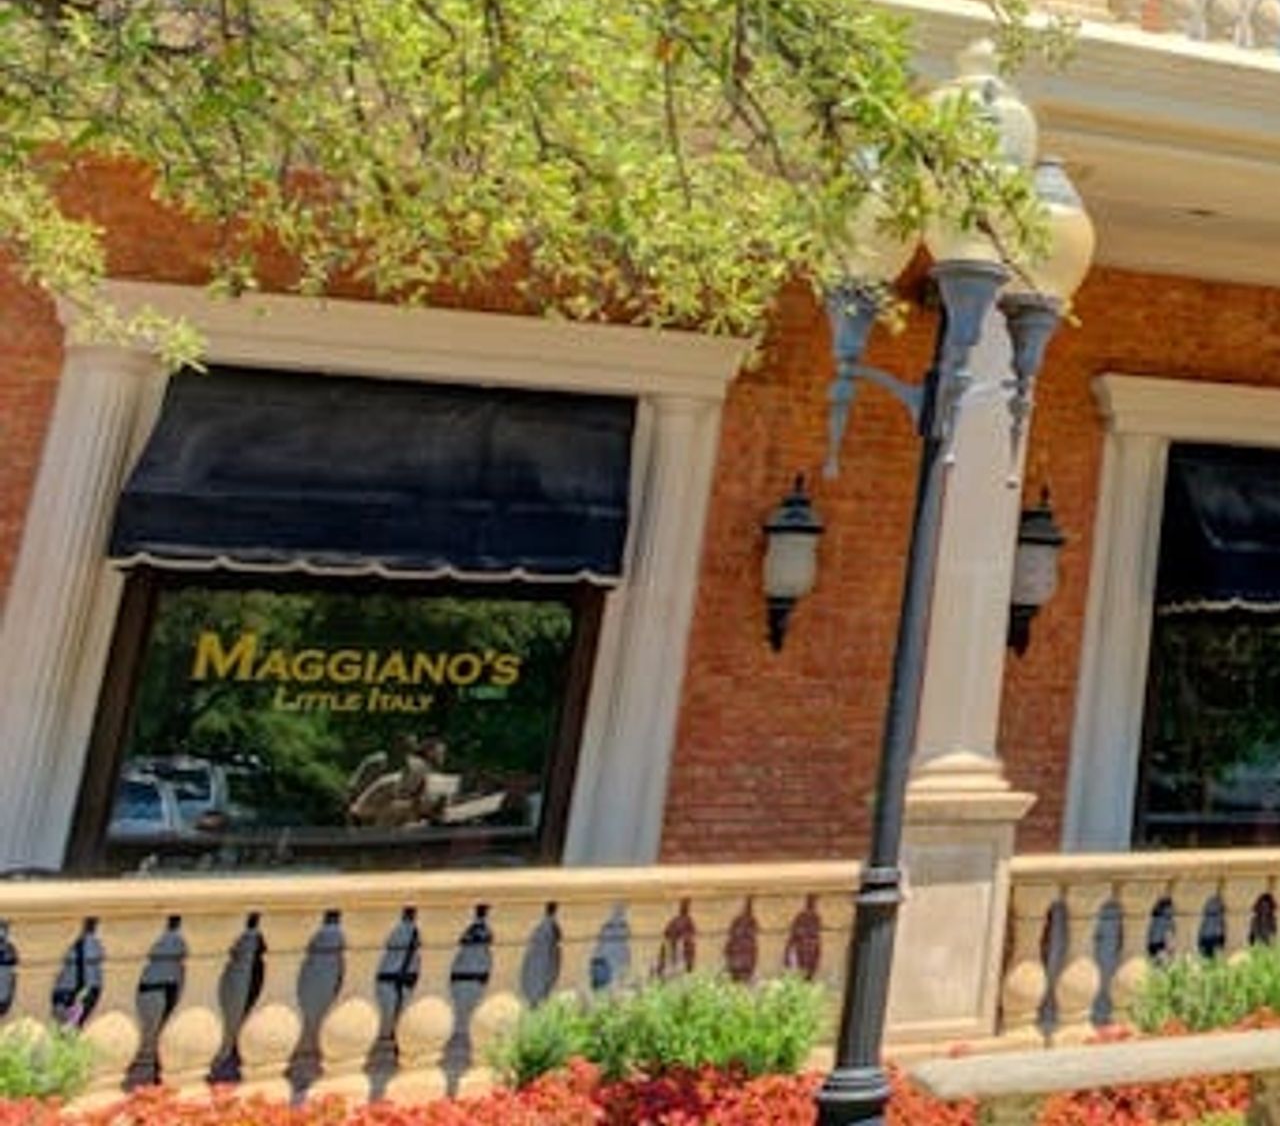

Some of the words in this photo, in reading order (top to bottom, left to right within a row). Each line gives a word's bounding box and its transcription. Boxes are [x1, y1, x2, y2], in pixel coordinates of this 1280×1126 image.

[192, 631, 523, 685] MAGGIANO'S
[273, 686, 363, 712] LITTLE
[367, 686, 435, 712] ITALY
